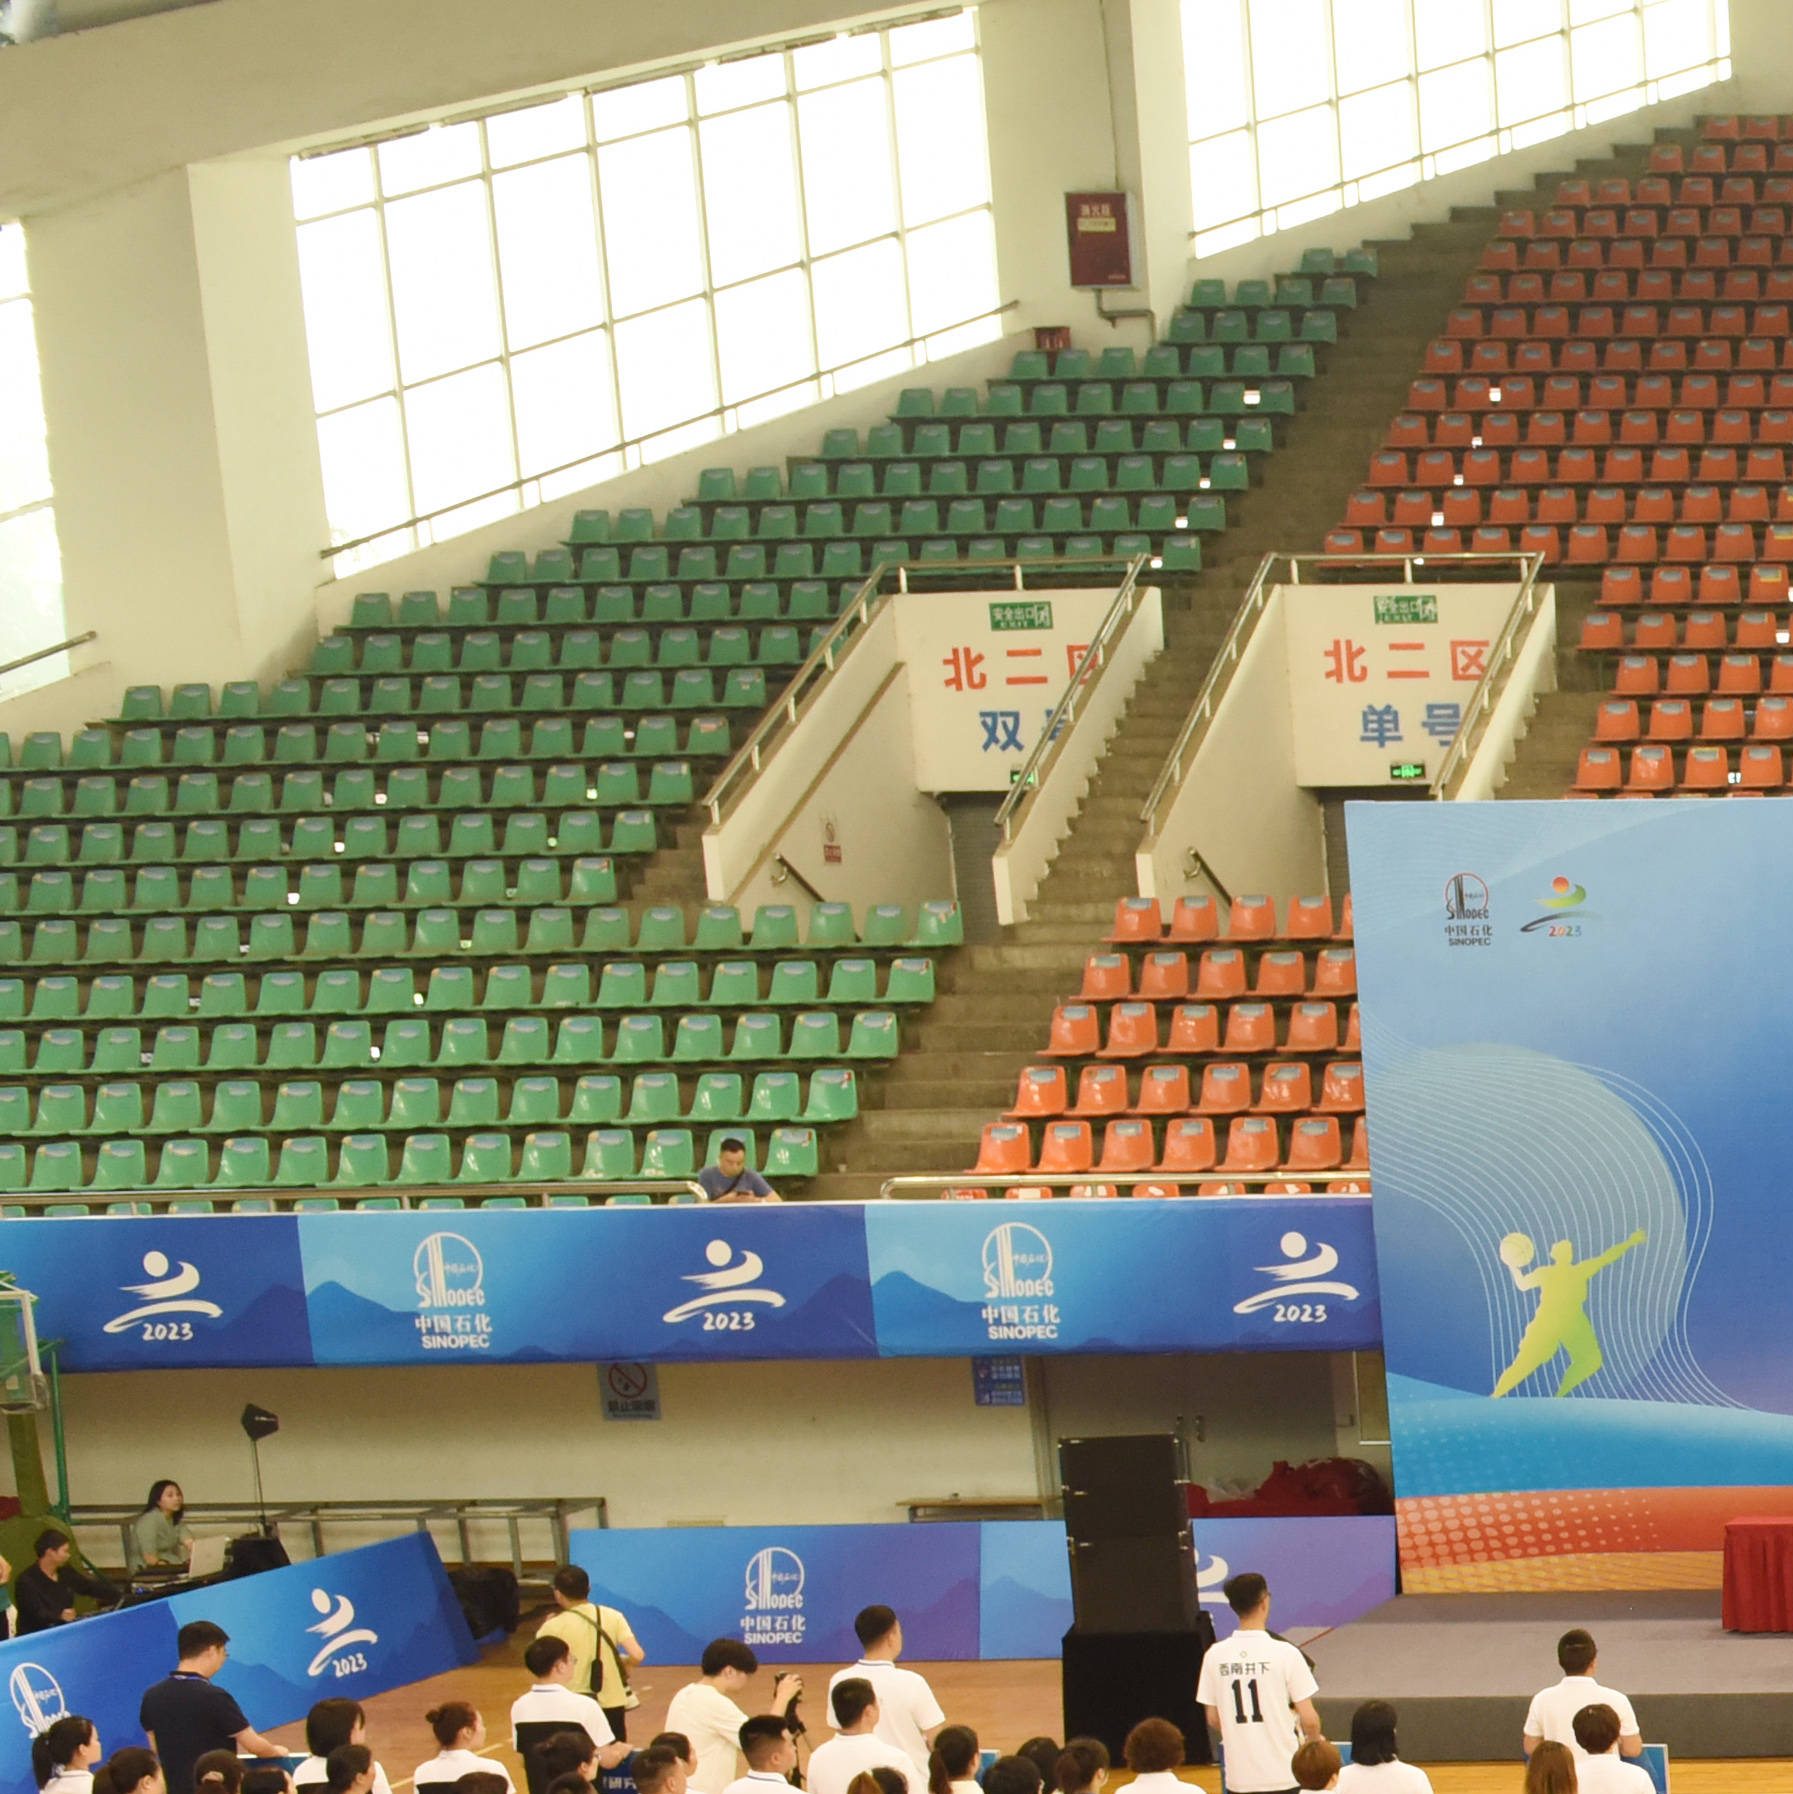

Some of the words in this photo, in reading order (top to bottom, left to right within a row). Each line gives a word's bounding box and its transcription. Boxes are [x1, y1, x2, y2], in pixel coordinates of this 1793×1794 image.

[992, 607, 1034, 619] 安全出口
[1324, 640, 1494, 683] 北二区
[1445, 925, 1493, 936] 中国石化
[1549, 925, 1582, 937] 2023
[1448, 937, 1491, 946] SINOPEC
[703, 1312, 755, 1331] 2023
[982, 1305, 1061, 1324] 中国石化
[1273, 1303, 1327, 1323] 2023
[142, 1322, 194, 1342] 2023
[415, 1314, 493, 1333] 中国石化
[989, 1326, 1059, 1339] SINOPEC
[422, 1335, 491, 1349] SINOPEC
[740, 1615, 806, 1632] 中国石化
[744, 1632, 803, 1645] SINOPEC
[334, 1656, 368, 1678] 2023
[1231, 1679, 1264, 1724] 11
